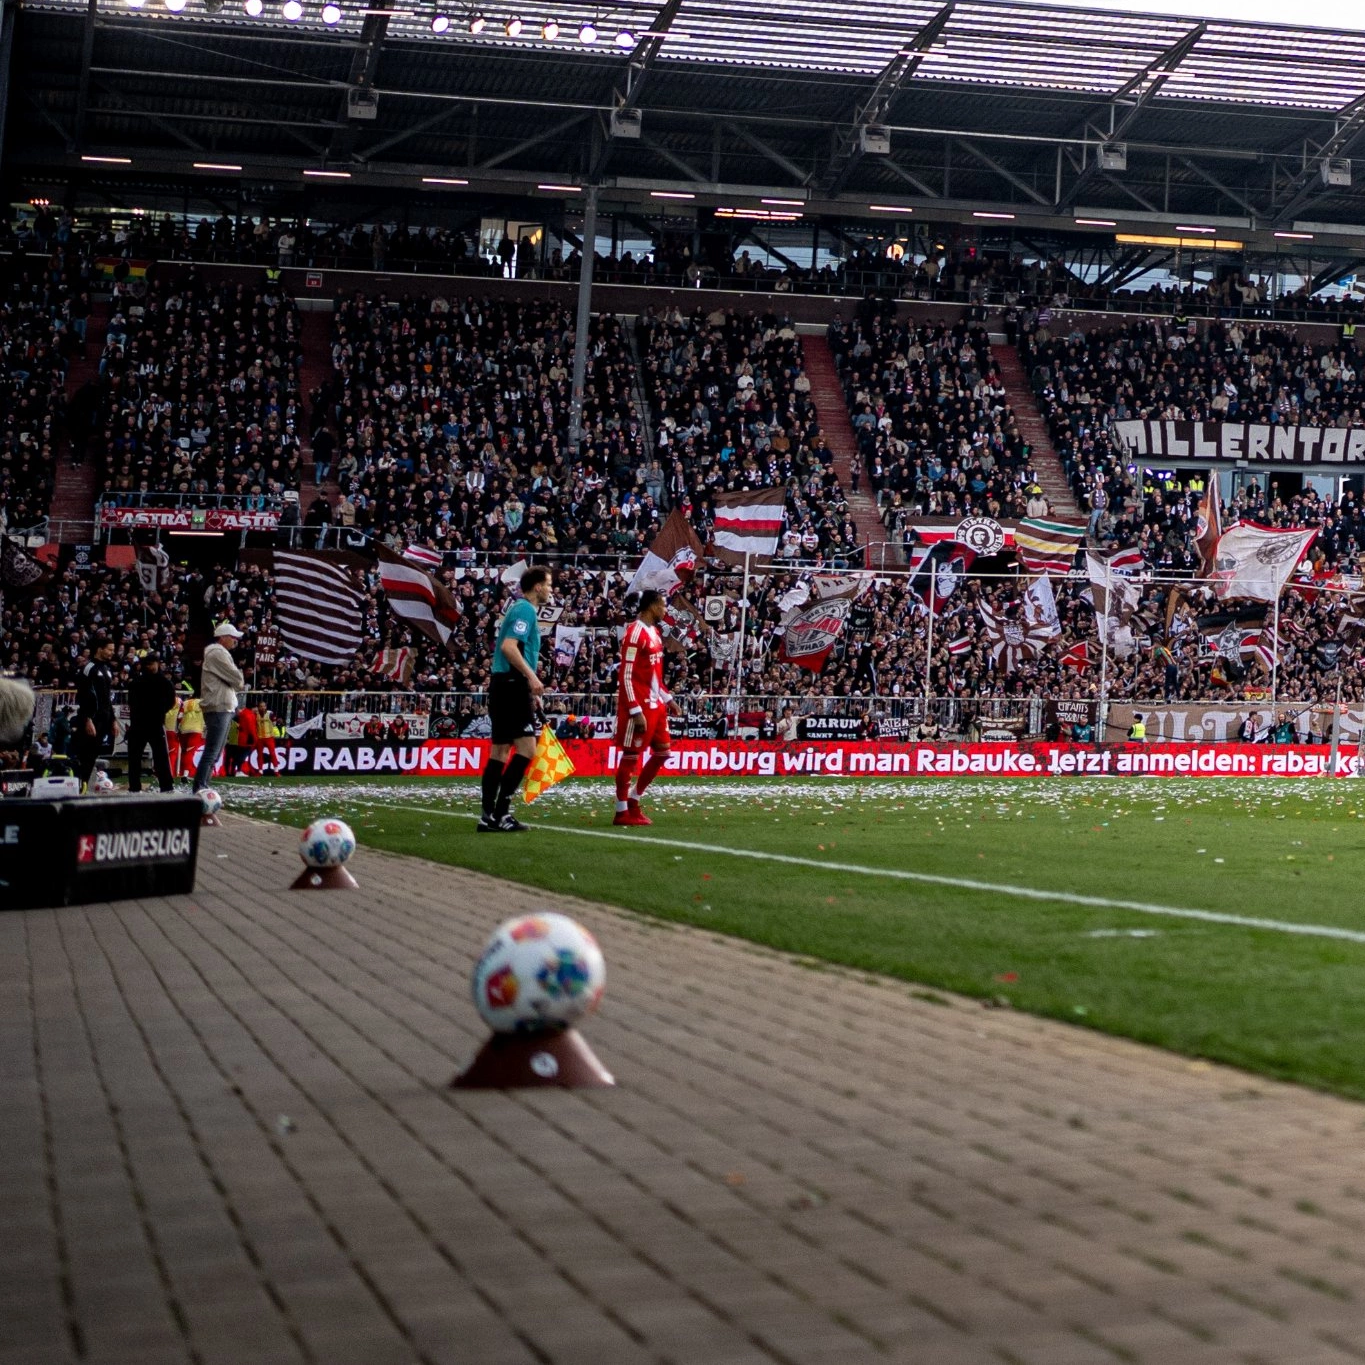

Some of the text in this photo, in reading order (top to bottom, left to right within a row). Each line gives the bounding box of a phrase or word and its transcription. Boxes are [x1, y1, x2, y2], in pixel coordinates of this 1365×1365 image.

[120, 512, 189, 526] ASTRA
[223, 514, 281, 527] ASTR
[806, 717, 863, 728] DARUM
[243, 746, 481, 771] CSP RABAUKEN
[782, 748, 843, 771] wird
[851, 752, 910, 771] man
[917, 748, 1042, 772] Rabauke.
[1047, 748, 1112, 772] Jetzt
[1116, 749, 1256, 773] anmelden:
[95, 829, 191, 861] BUNDESLIGA
